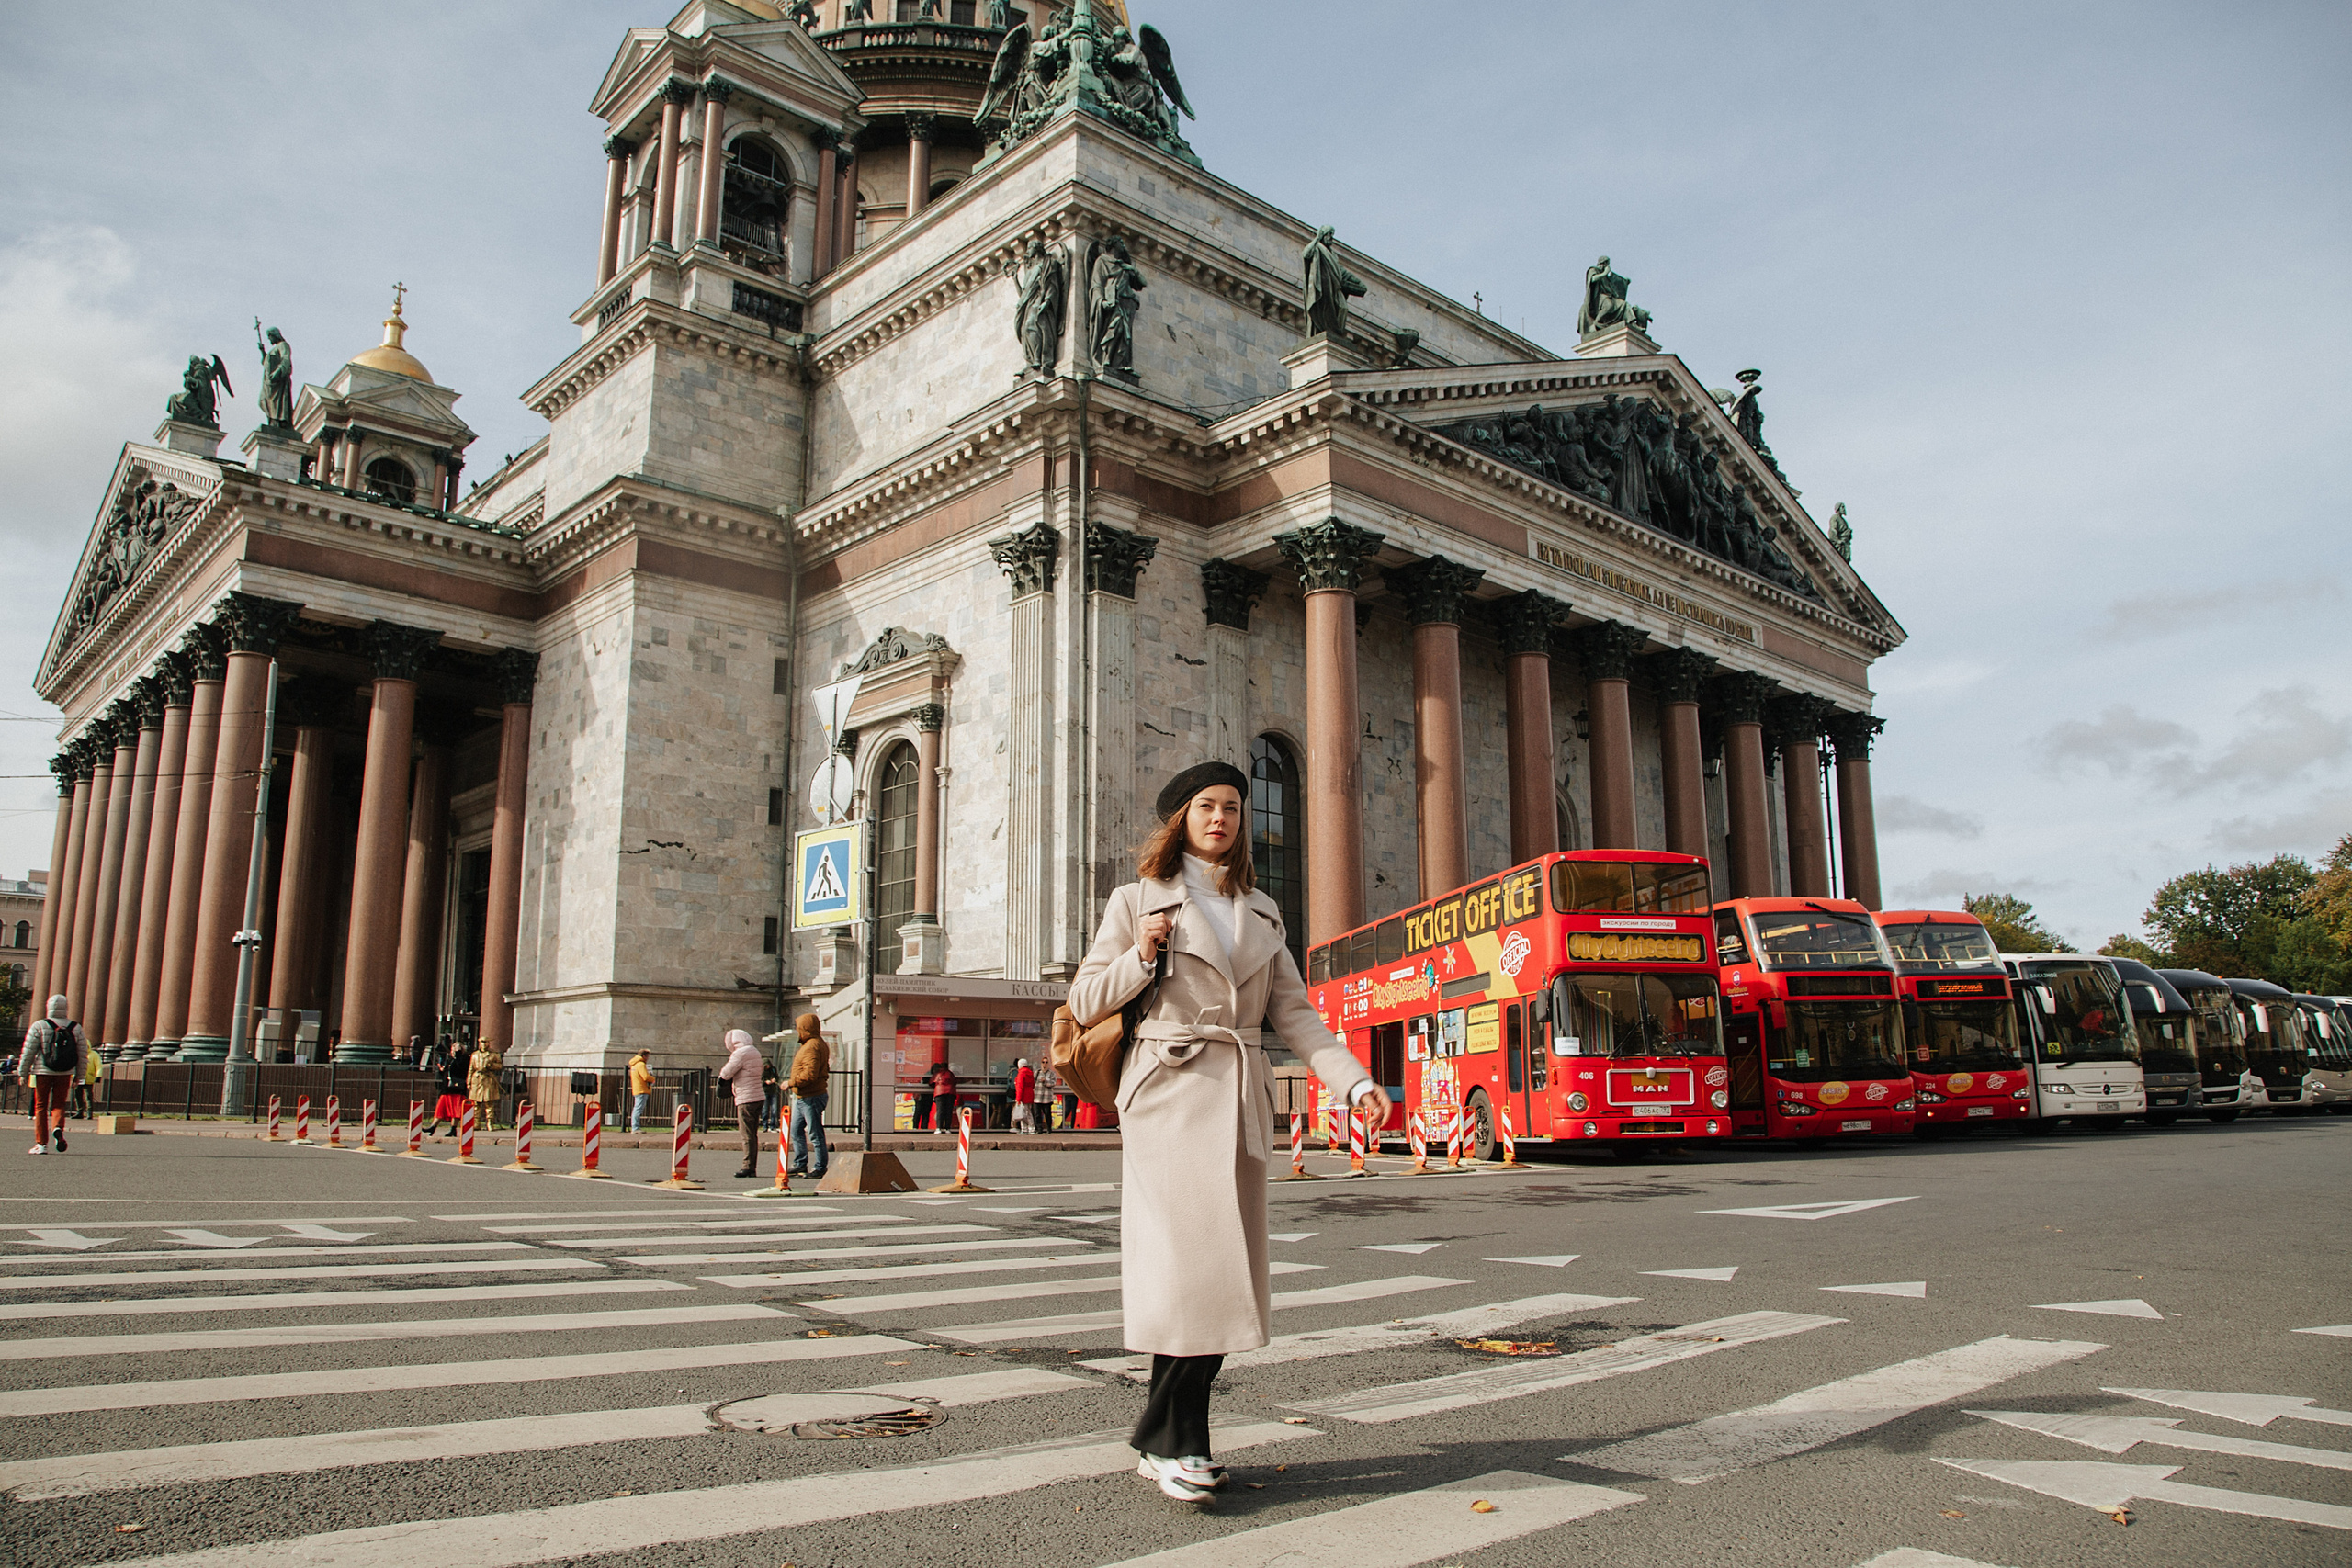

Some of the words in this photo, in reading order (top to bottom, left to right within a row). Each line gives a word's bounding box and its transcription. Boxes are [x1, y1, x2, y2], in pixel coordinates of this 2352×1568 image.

[1406, 900, 1461, 952] TICKET
[1464, 874, 1536, 933] OFFICE
[1503, 942, 1528, 968] OFFICIAL
[876, 977, 936, 987] МУЗЕЙ-ПАМЯТНИК
[876, 985, 927, 993] ИСААКИЕВСКИЙ
[1012, 983, 1059, 998] КАССЫ
[1578, 1071, 1594, 1080] 406
[1791, 1091, 1804, 1100] 698
